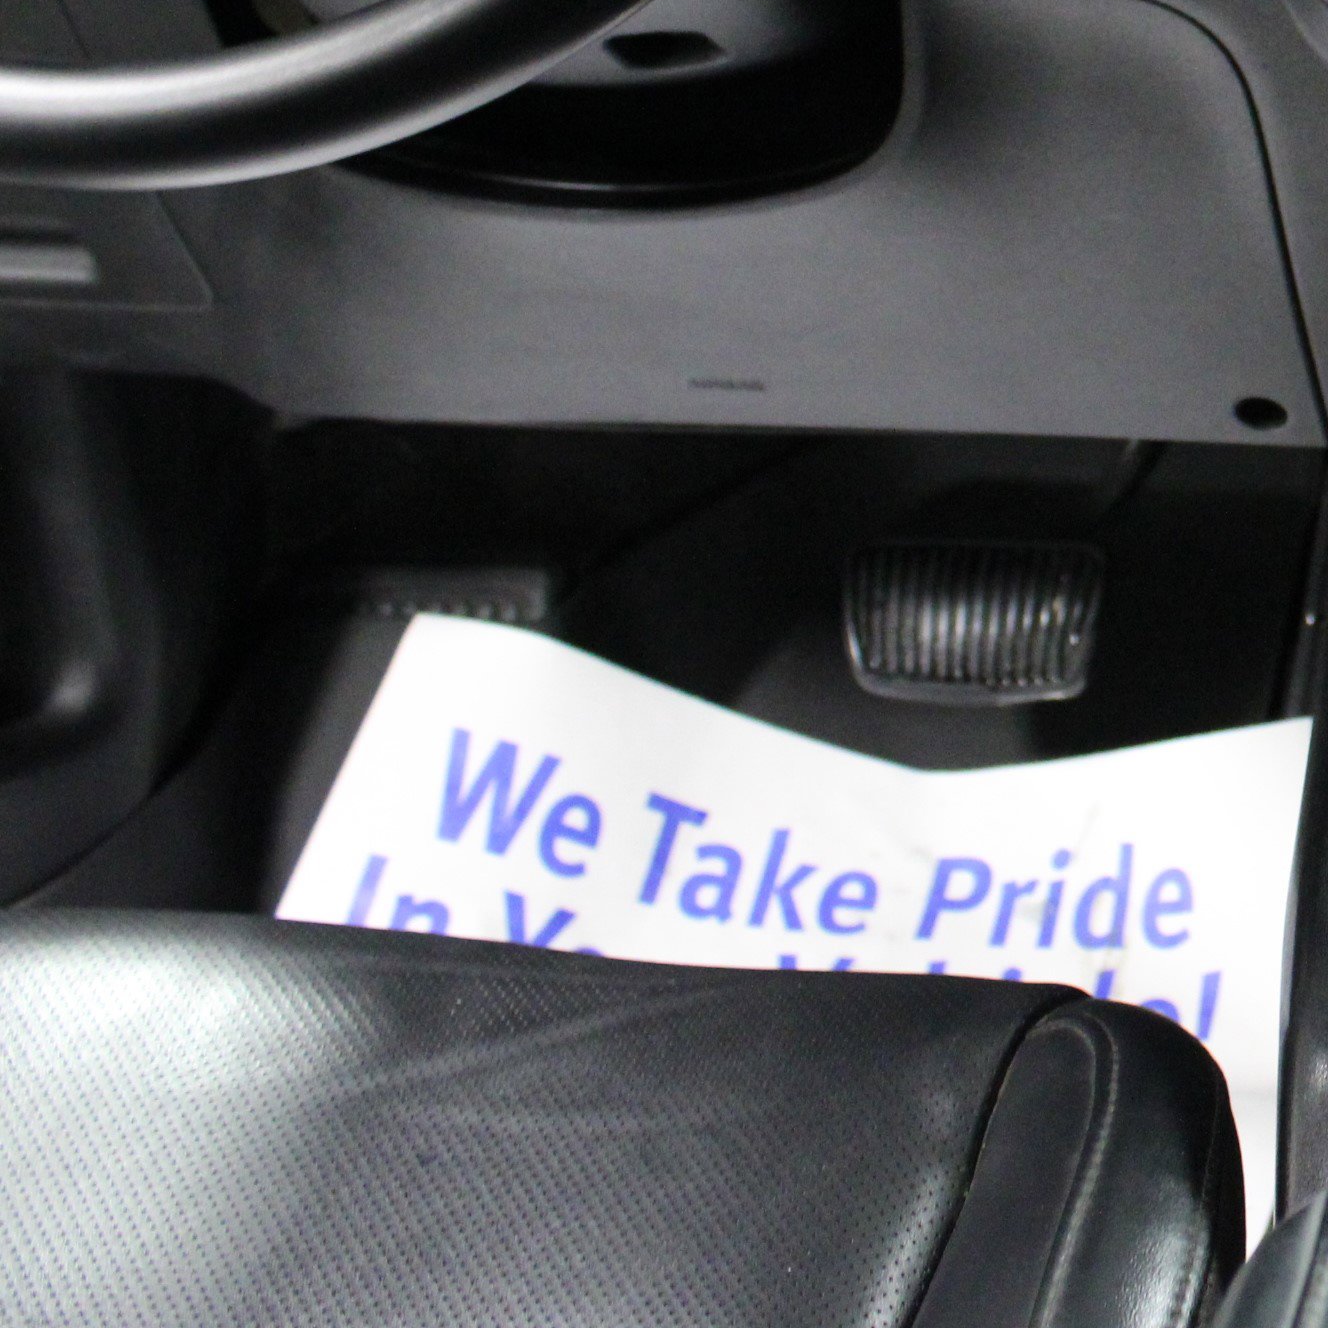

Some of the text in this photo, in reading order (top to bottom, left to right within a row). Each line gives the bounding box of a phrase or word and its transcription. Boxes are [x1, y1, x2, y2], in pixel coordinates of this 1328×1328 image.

[436, 727, 602, 879] We
[636, 792, 880, 934] Take
[915, 842, 1194, 952] Pride
